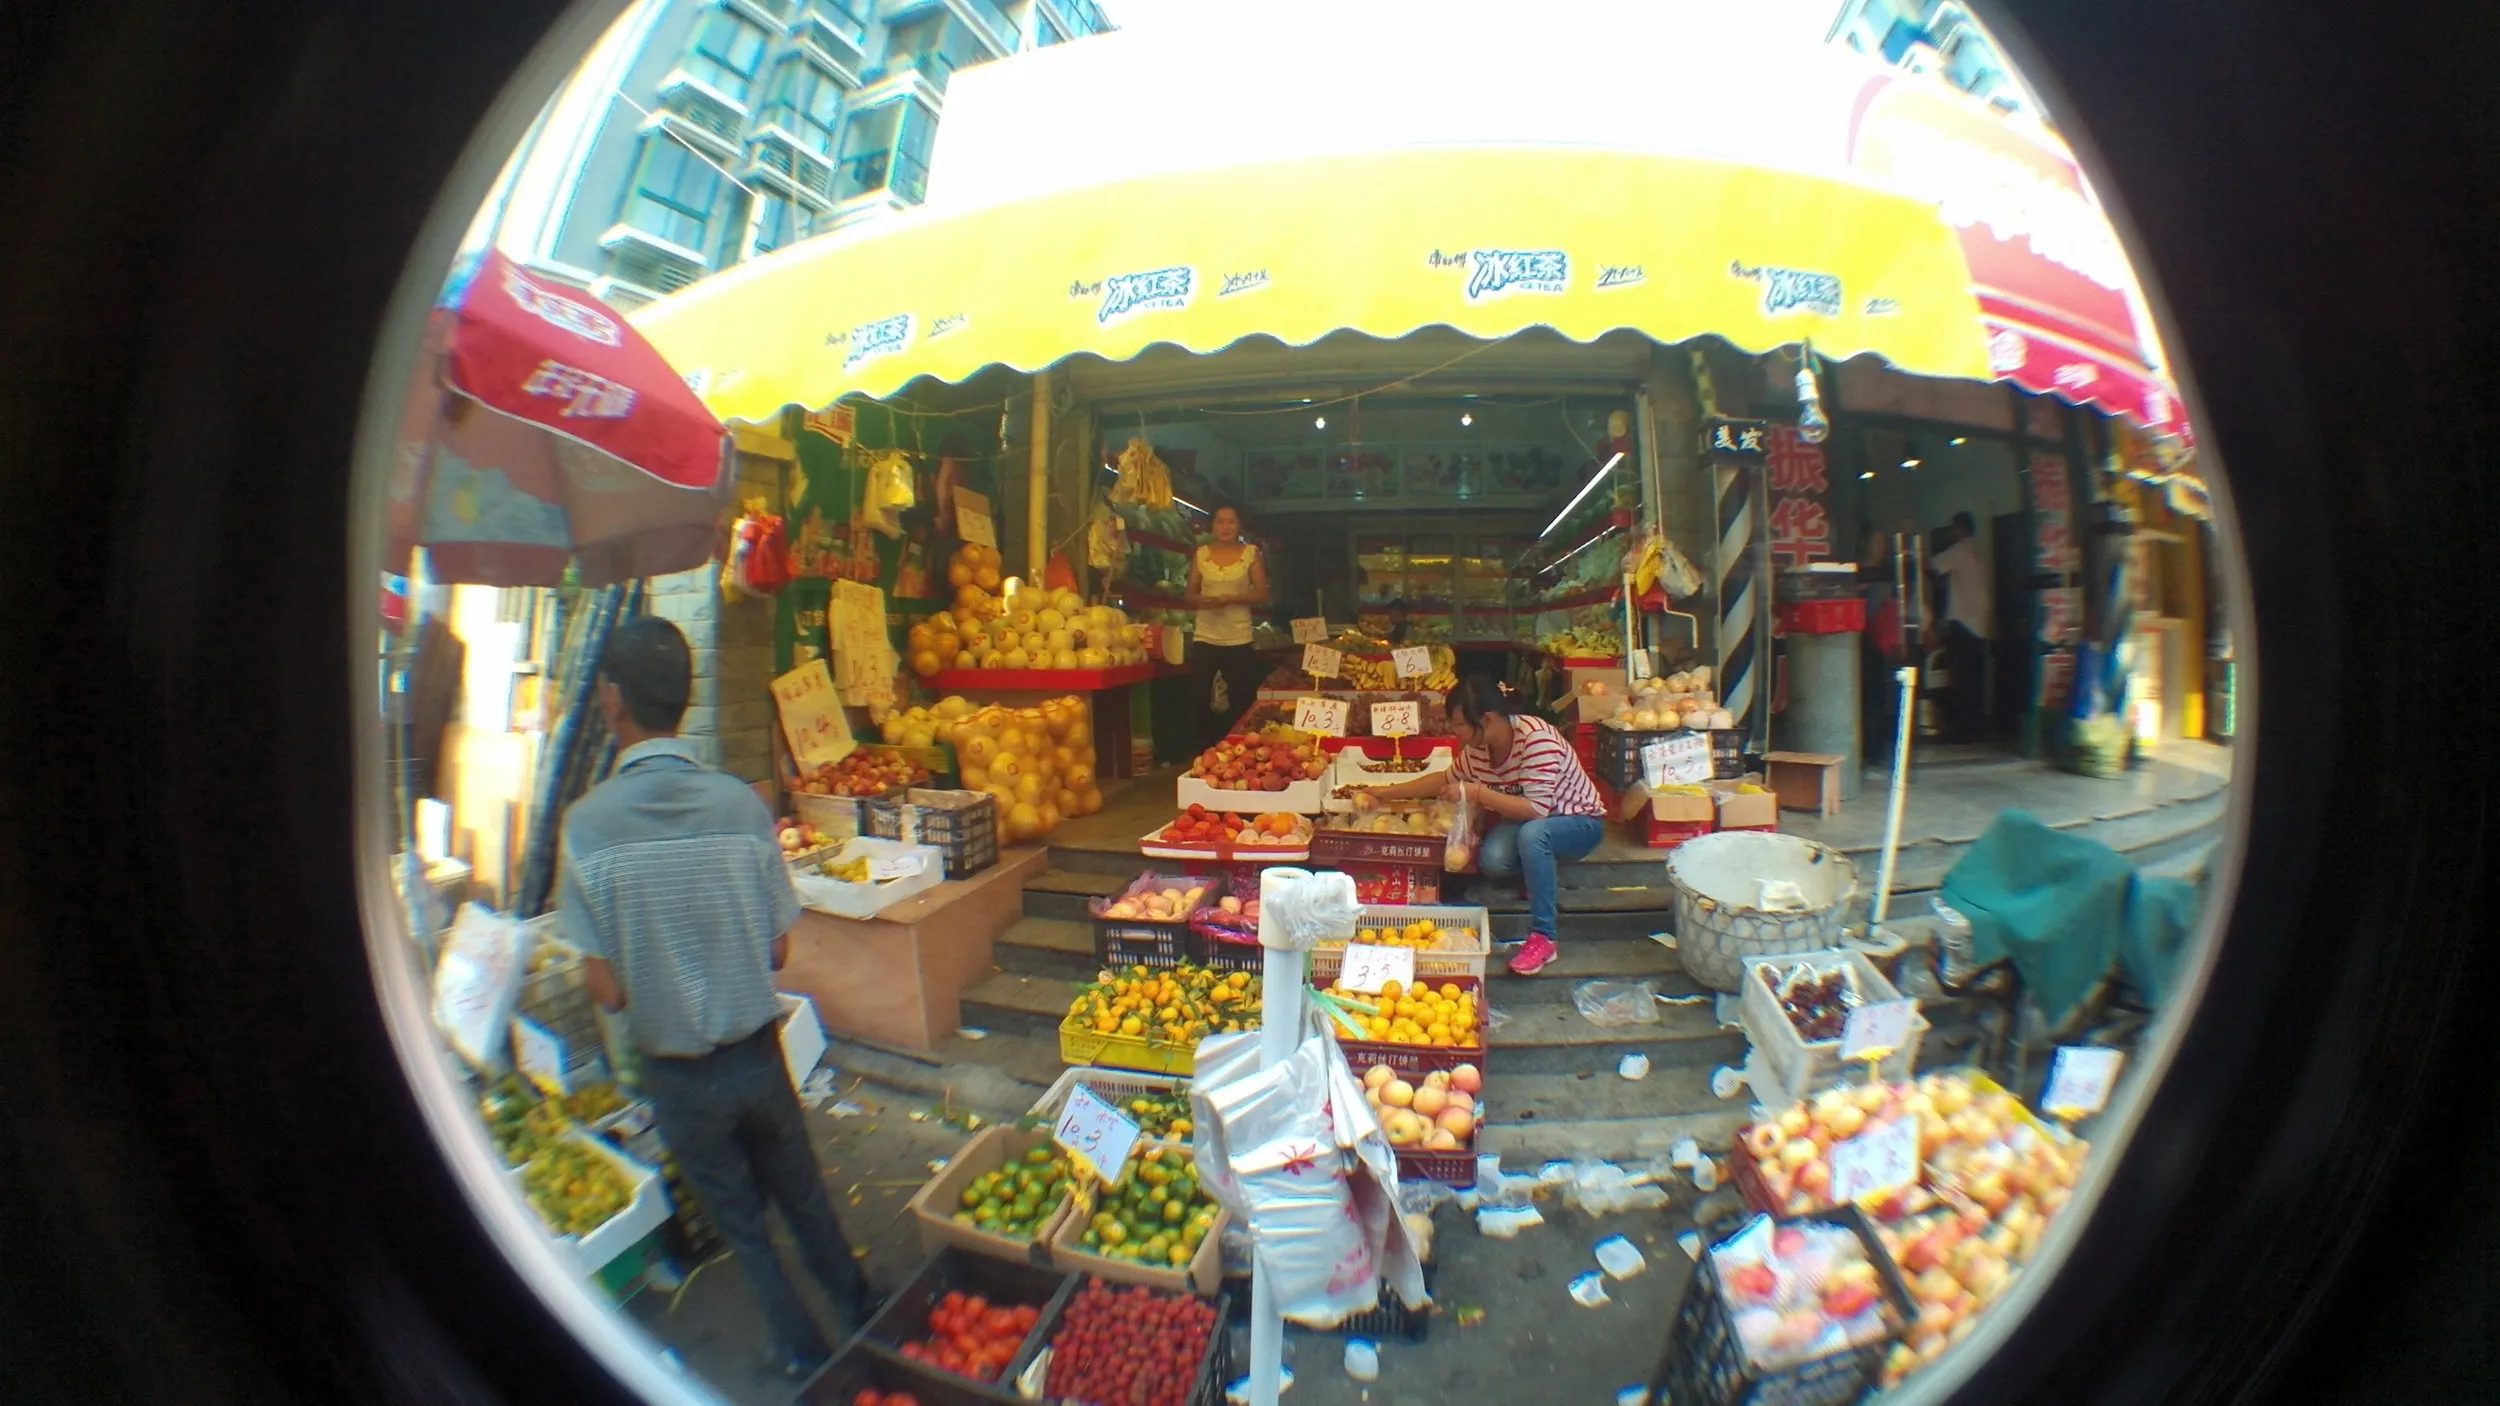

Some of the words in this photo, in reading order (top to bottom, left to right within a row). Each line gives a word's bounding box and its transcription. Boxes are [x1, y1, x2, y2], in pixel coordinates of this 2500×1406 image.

[1099, 266, 1190, 322] 冰红茶
[1468, 250, 1566, 298] 冰红茶
[1713, 424, 1763, 451] 美发
